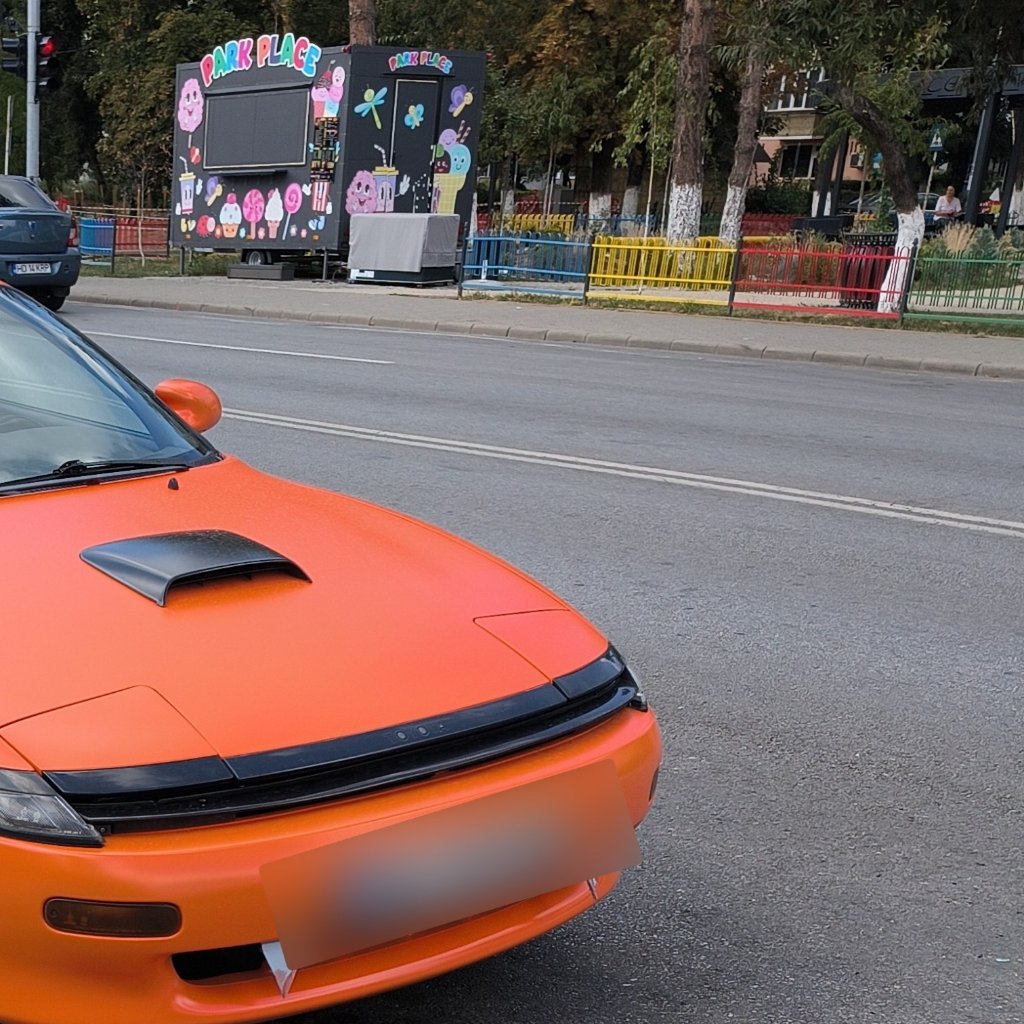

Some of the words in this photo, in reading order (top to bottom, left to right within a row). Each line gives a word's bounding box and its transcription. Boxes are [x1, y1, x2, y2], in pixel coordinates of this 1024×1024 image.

[200, 38, 254, 87] PARK
[257, 33, 321, 77] PLACE
[388, 51, 419, 71] PARK
[420, 51, 453, 74] PLACE
[17, 264, 27, 272] HD
